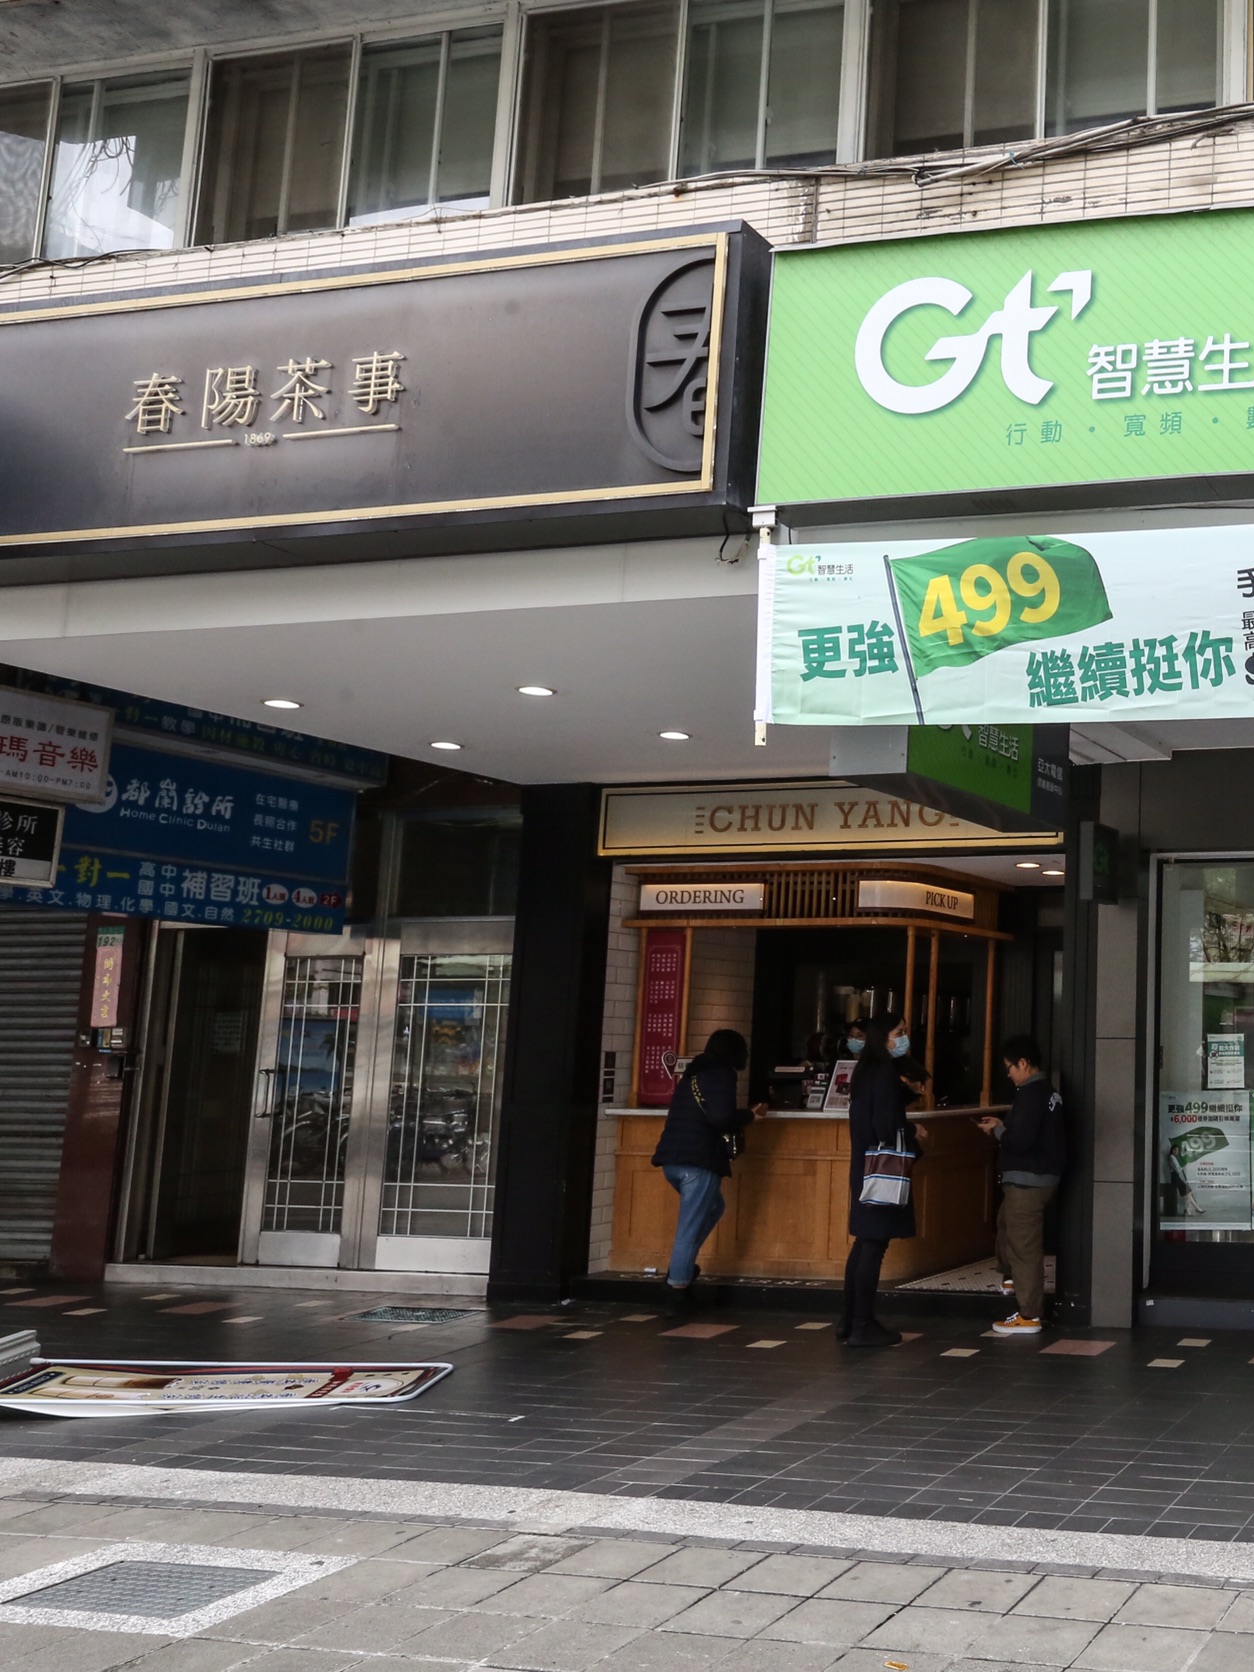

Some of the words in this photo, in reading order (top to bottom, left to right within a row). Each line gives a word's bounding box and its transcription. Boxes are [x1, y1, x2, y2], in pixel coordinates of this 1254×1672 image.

[124, 350, 406, 434] 春陽茶事
[244, 431, 277, 446] 1869
[818, 563, 854, 576] 智慧生活
[919, 551, 1061, 646] 499
[797, 620, 899, 683] 更強
[1025, 629, 1235, 708] 繼續挺你
[0, 735, 99, 773] 瑪音樂
[120, 806, 156, 822] Home
[158, 812, 194, 828] Clinic
[196, 818, 230, 833] Dulan
[709, 802, 818, 834] CHUN
[834, 799, 947, 830] YANG
[308, 819, 340, 845] 5F
[0, 836, 26, 857] 容
[250, 835, 295, 853] 共生社群
[138, 861, 177, 880] 高中
[137, 879, 176, 897] 國中
[181, 868, 262, 906] 補習班
[655, 889, 745, 905] ORDERING
[322, 894, 338, 906] 2F
[925, 891, 944, 908] PICK
[945, 895, 959, 910] UP
[241, 908, 334, 931] 2709-2000
